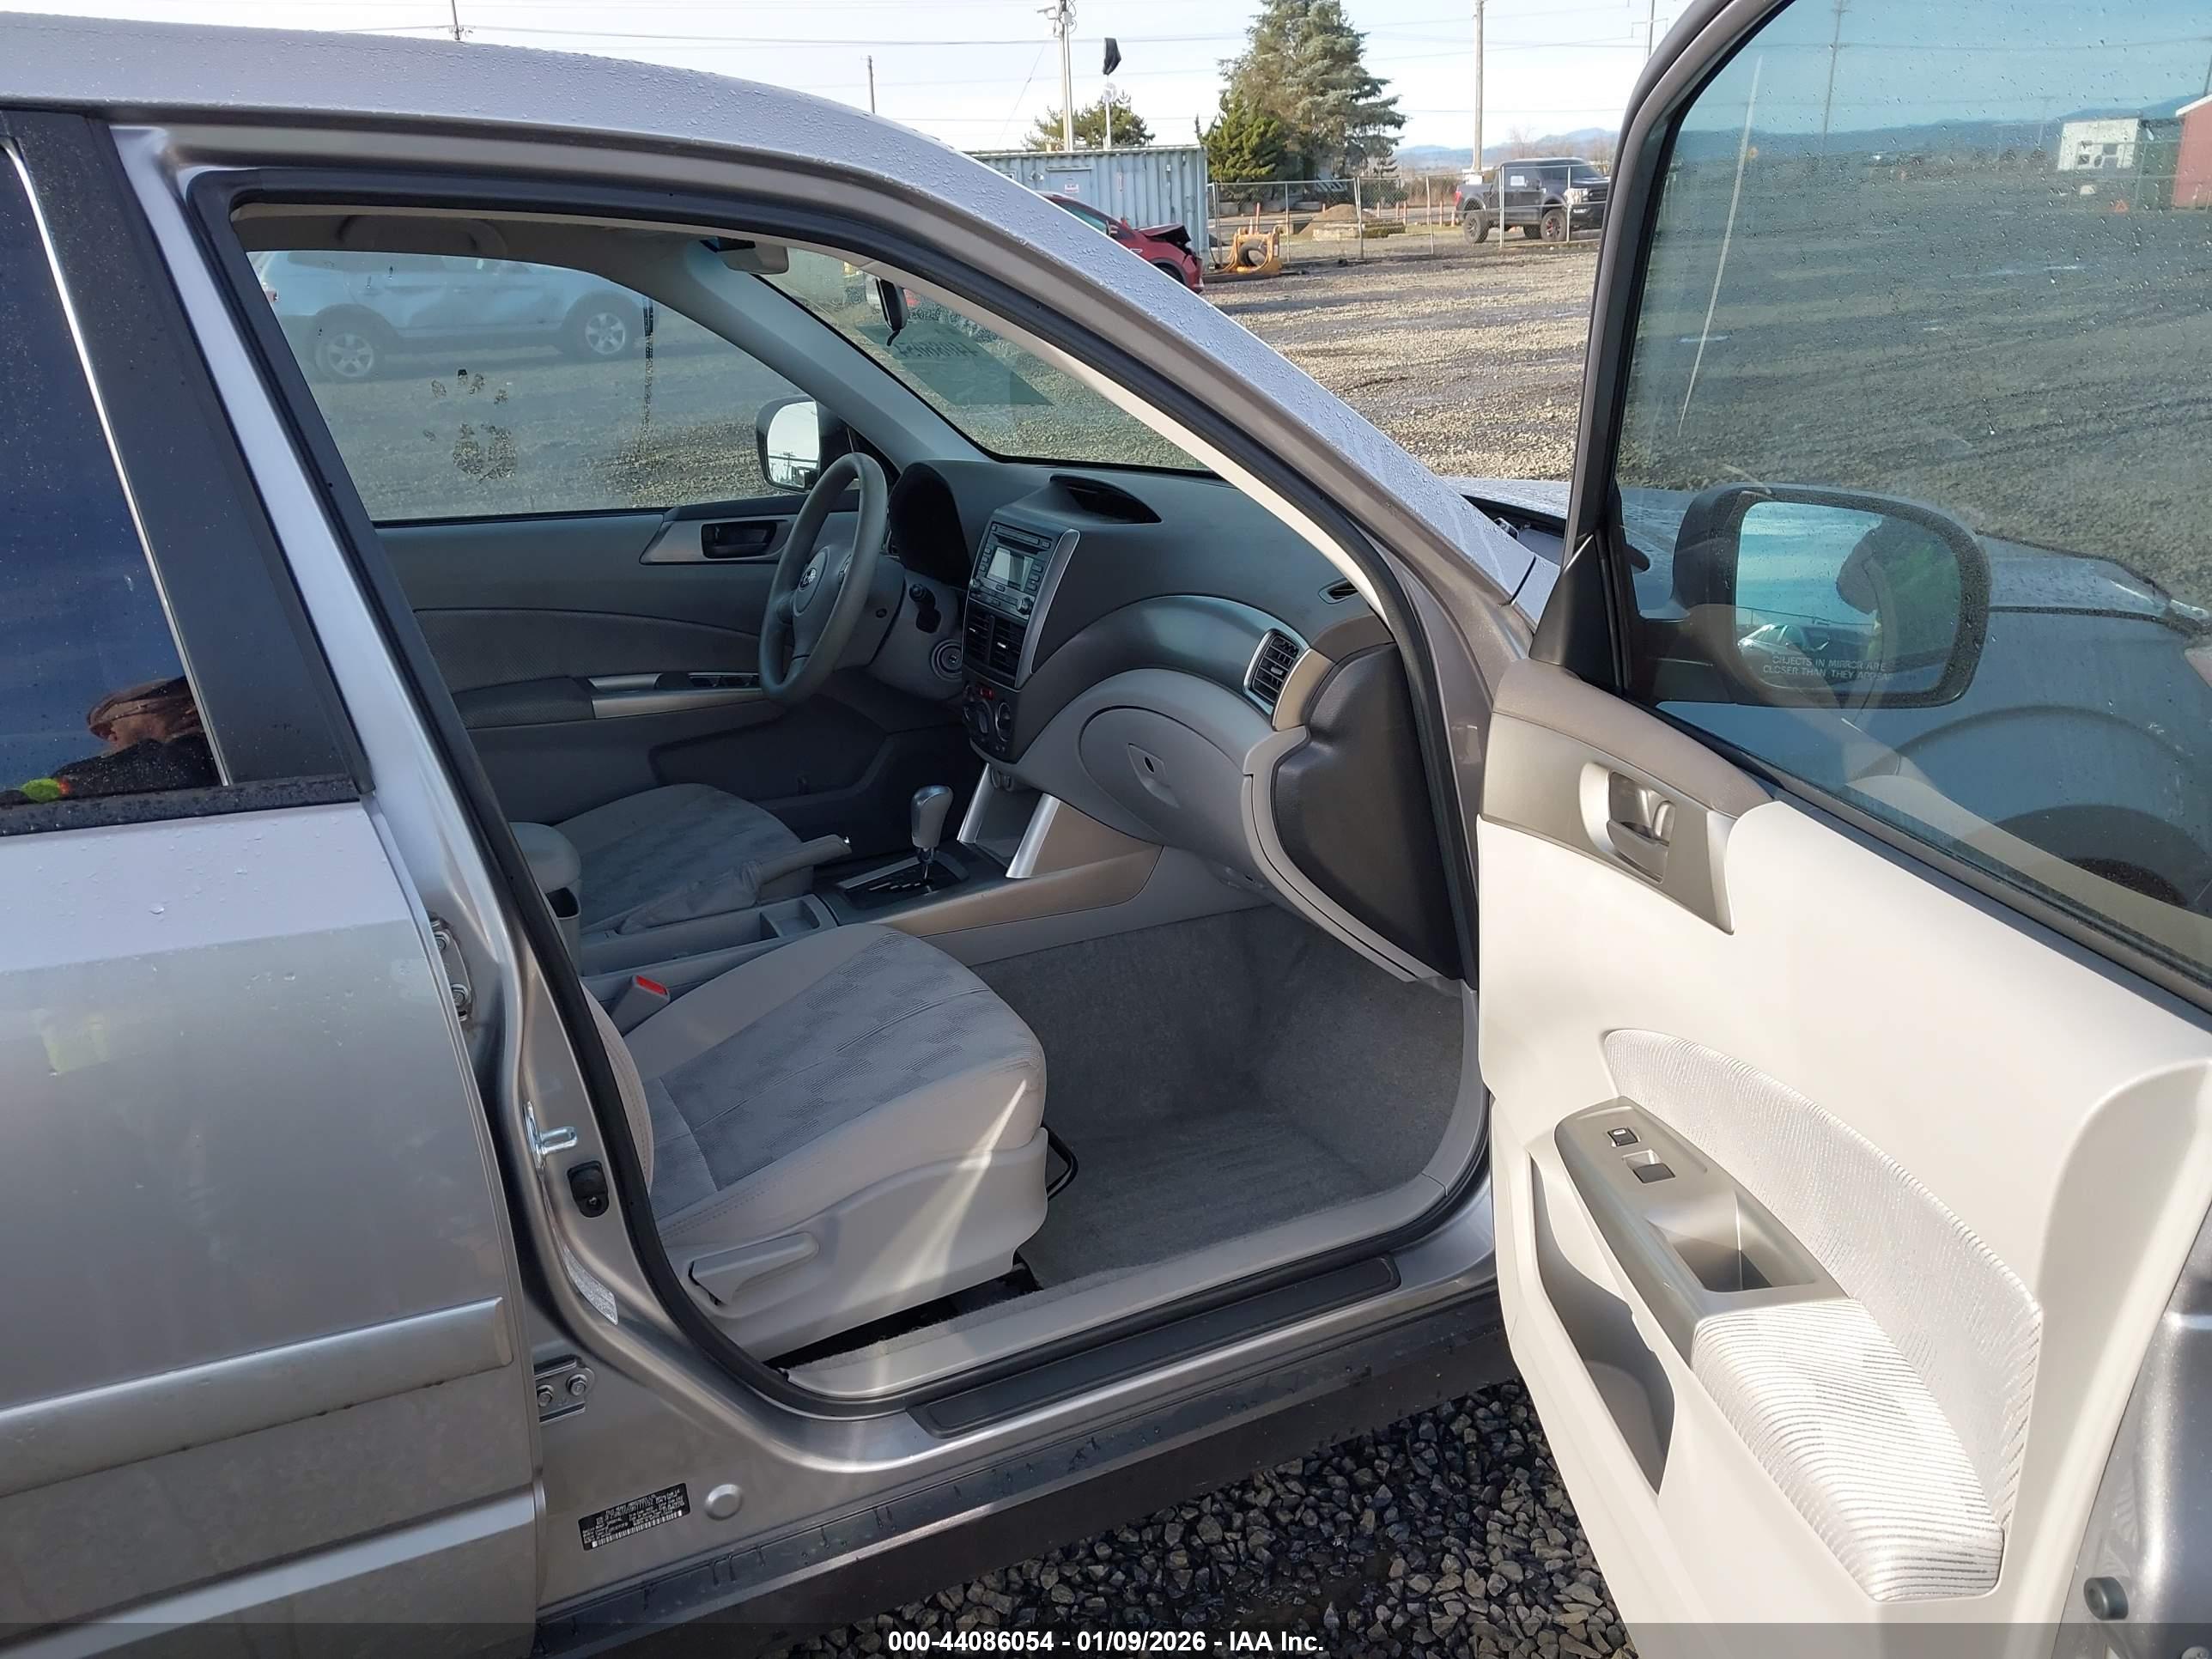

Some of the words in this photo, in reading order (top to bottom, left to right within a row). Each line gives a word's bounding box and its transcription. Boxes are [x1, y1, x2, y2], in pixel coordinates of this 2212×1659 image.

[1771, 655, 1813, 666] OBJECTS
[1815, 658, 1826, 667] IN
[1828, 659, 1863, 670] MIRROR
[1865, 661, 1886, 672] ARE
[1763, 665, 1799, 675] CLOSER
[1802, 667, 1826, 677] THAN
[1831, 669, 1855, 679] THEY
[1856, 671, 1895, 681] APPEAR
